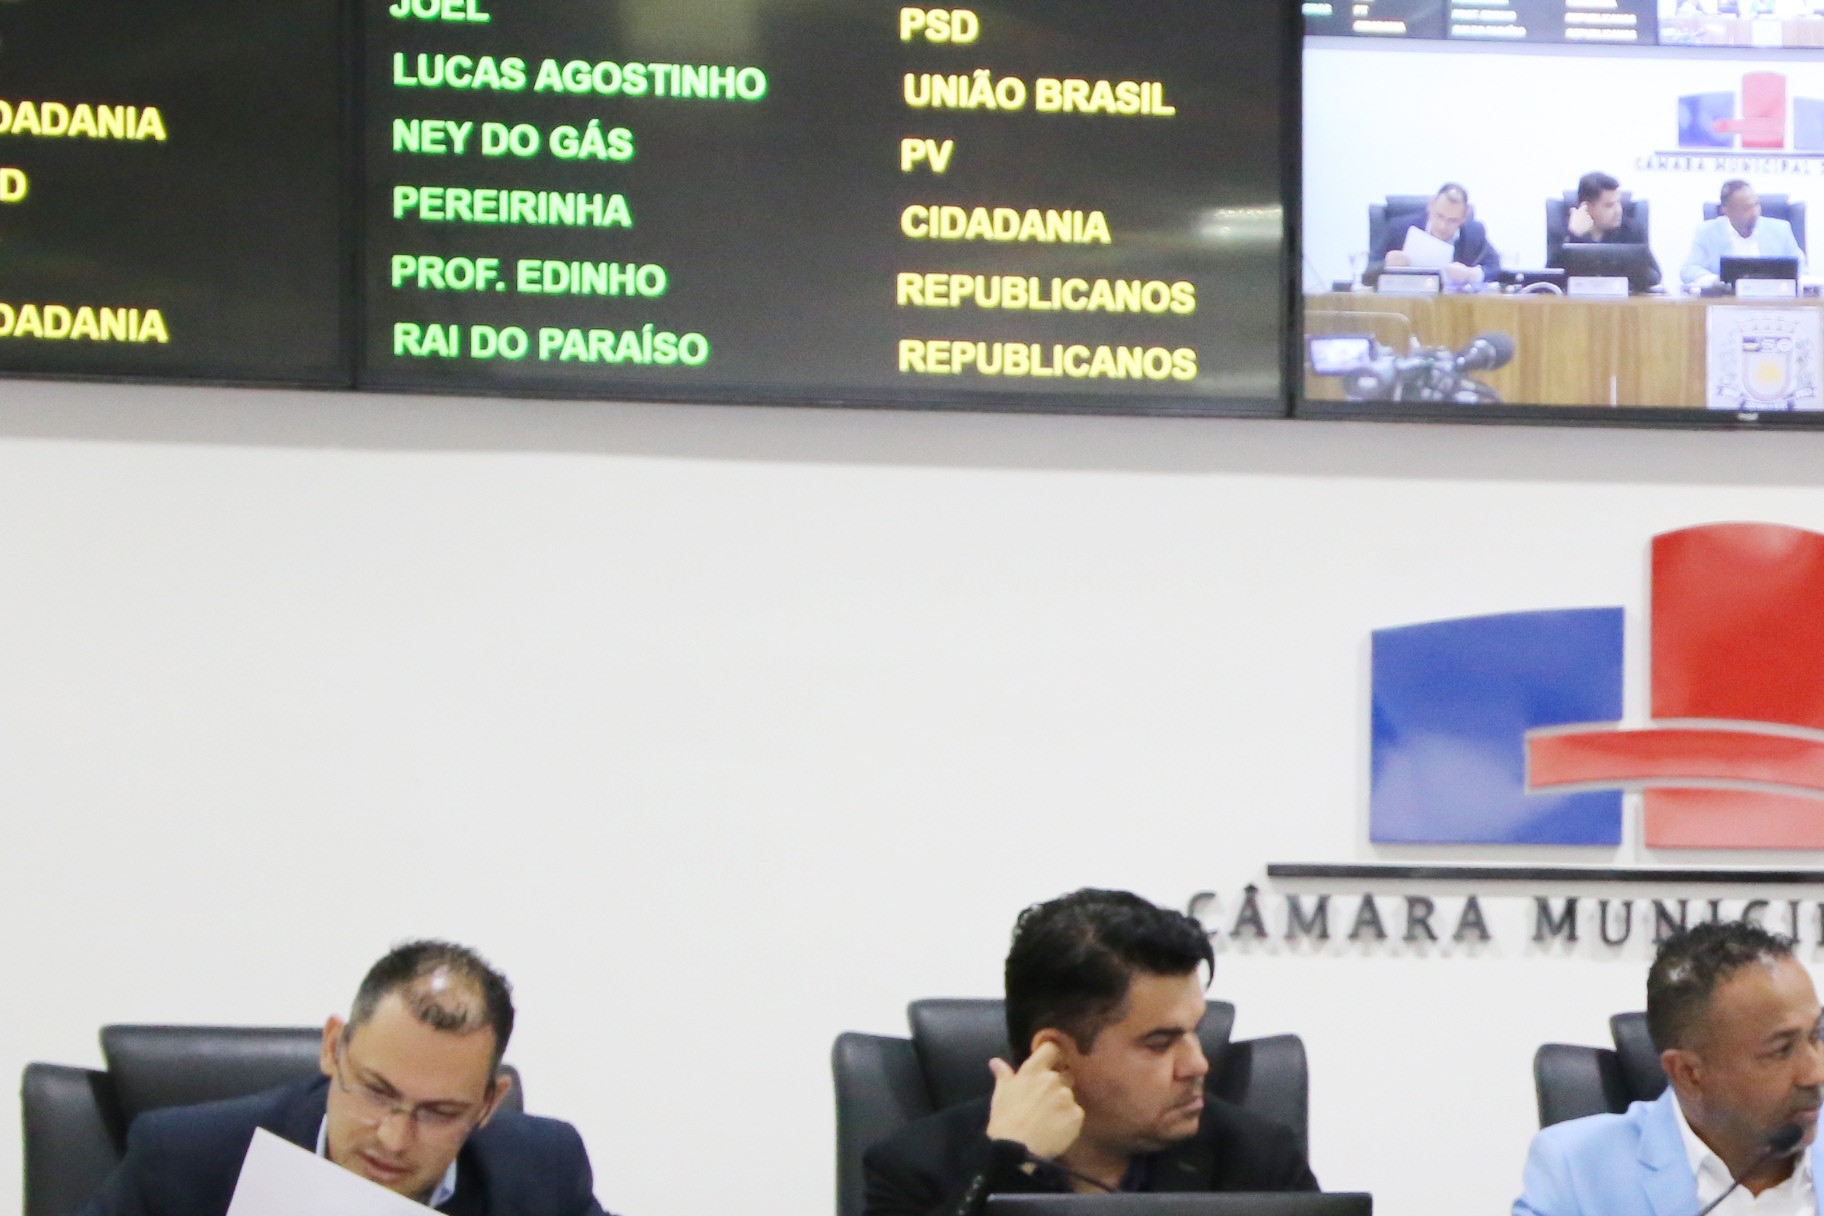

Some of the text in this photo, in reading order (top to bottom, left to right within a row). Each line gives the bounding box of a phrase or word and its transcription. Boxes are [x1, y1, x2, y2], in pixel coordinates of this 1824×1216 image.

[390, 0, 490, 22] JOEL
[900, 8, 979, 43] PSD
[394, 53, 767, 100] LUCAS AGOSTINHO
[904, 69, 1175, 115] UNIÃO BRASIL
[393, 119, 634, 161] NEY DO GÁS
[901, 138, 953, 172] PV
[394, 186, 632, 227] PEREIRINHA
[901, 205, 1111, 244] CIDADANIA
[392, 255, 667, 297] PROF. EDINHO
[897, 273, 1195, 314] REPUBLICANOS
[394, 323, 709, 365] RAI DO PARAÍSO
[899, 340, 1197, 380] REPUBLICANOS
[1187, 884, 1491, 942] CÂMARA
